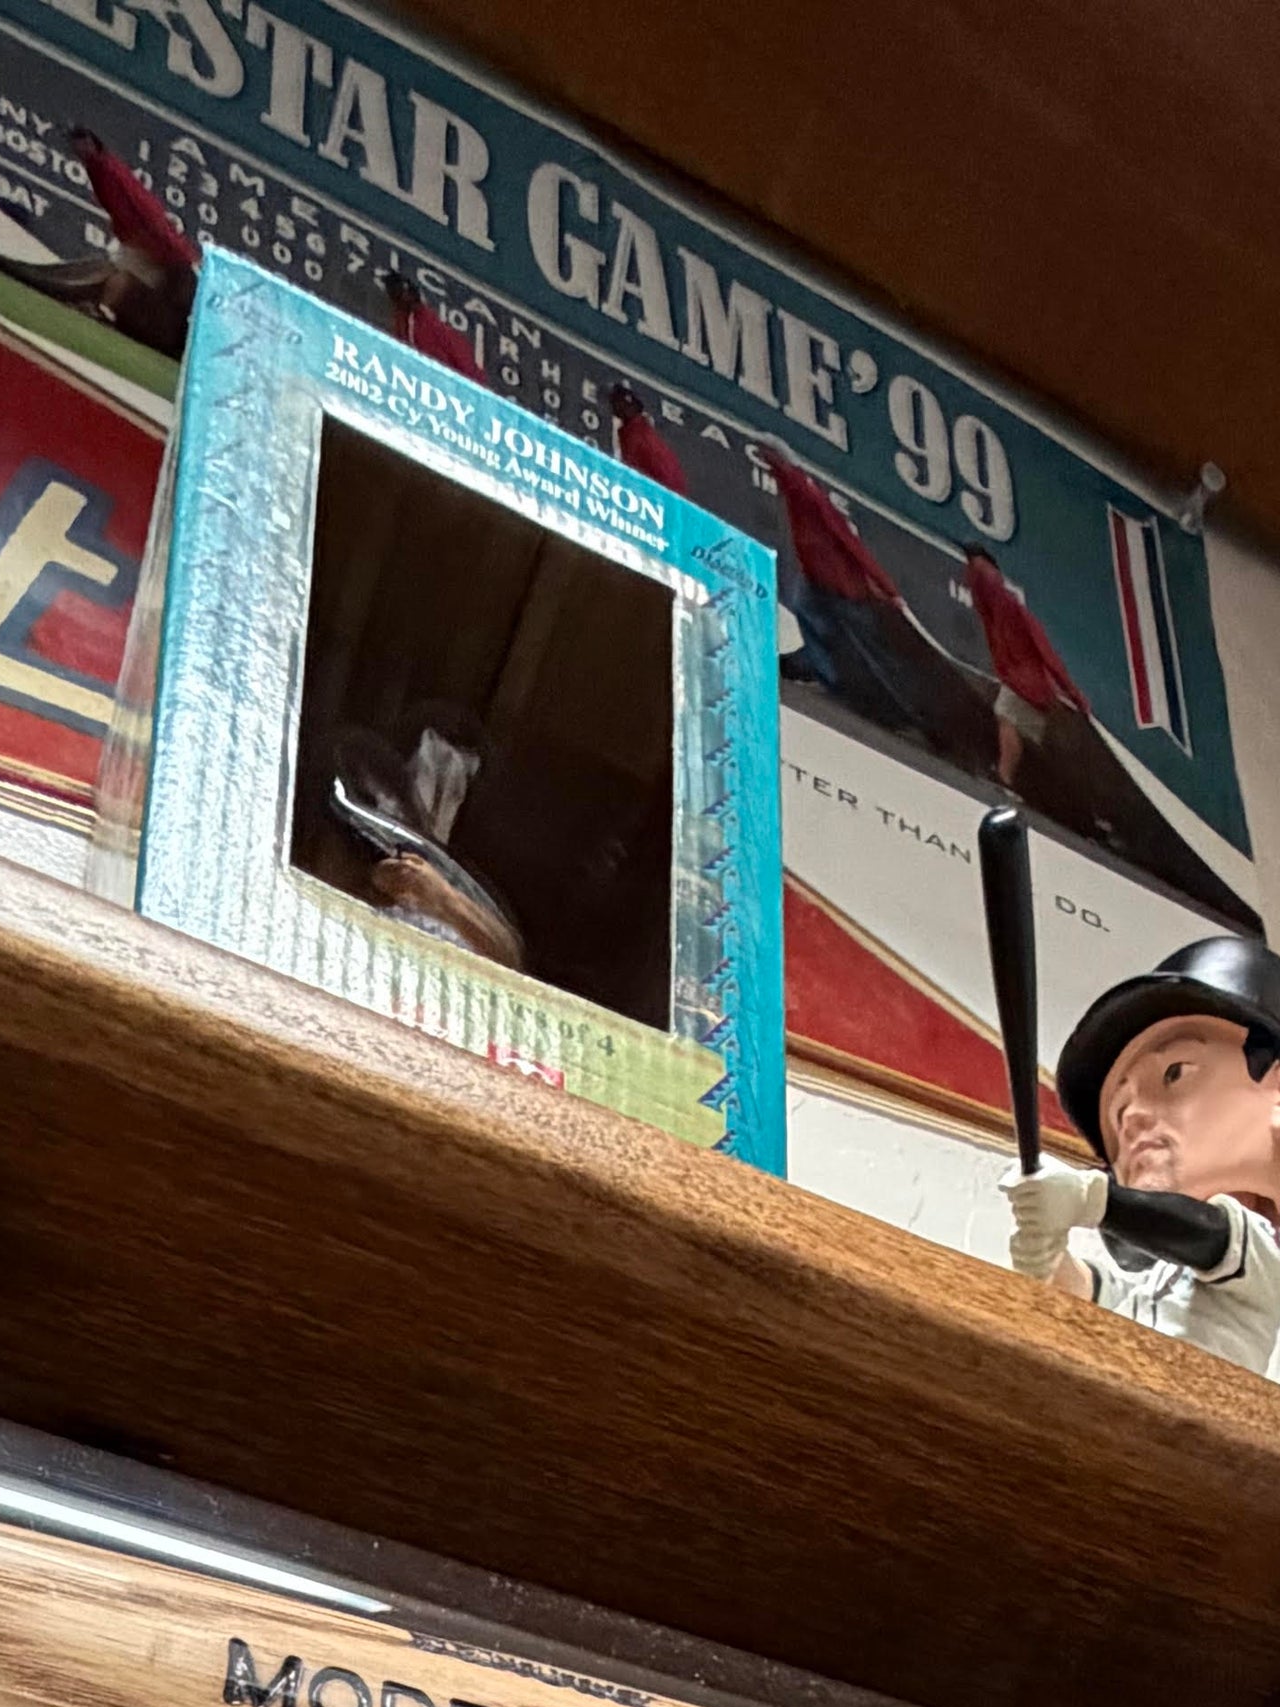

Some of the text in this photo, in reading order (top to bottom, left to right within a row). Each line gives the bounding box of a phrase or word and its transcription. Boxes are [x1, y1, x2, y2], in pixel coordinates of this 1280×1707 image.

[0, 96, 53, 136] NY
[324, 362, 670, 552] 2002 Cy Young Award Winner
[333, 335, 665, 531] RANDY JOHNSON
[875, 806, 971, 864] THAN
